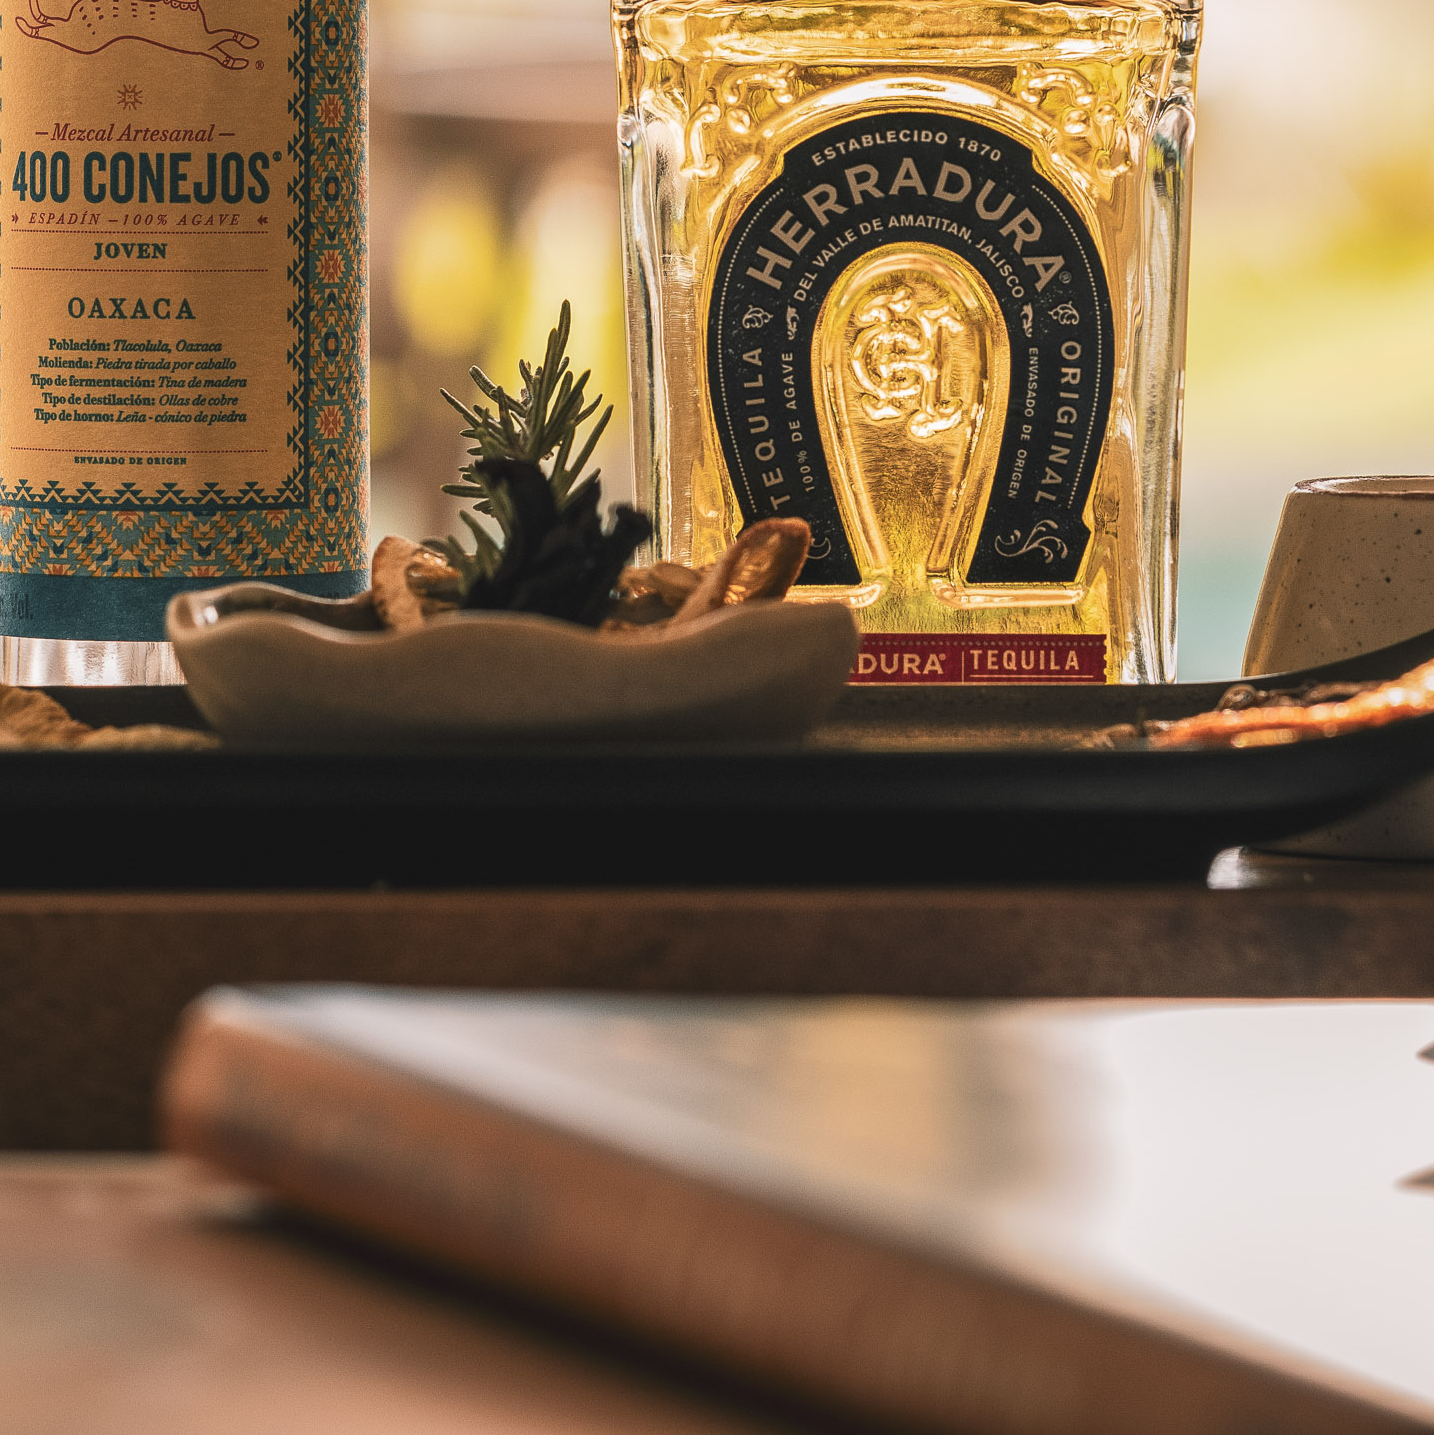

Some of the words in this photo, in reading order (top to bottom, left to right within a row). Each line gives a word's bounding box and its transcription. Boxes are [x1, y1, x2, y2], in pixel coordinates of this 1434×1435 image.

[117, 124, 216, 142] Artesanal
[811, 130, 948, 166] ESTABLECIDO
[958, 137, 1002, 162] 1870
[12, 151, 71, 203] 400
[28, 210, 101, 226] ESPADÍN
[177, 214, 240, 226] AGAVE
[94, 242, 167, 260] JOVEN
[794, 270, 818, 302] DEL
[812, 228, 858, 267] VALLE
[859, 218, 883, 235] DE
[975, 238, 1025, 298] JALISCO
[68, 297, 196, 320] OAXACA
[49, 338, 110, 352] Población:
[175, 339, 222, 352] Oaxaca
[38, 356, 93, 369] Molienda:
[95, 357, 132, 370] Piedra
[134, 358, 170, 370] tirada
[170, 361, 194, 373] por
[194, 358, 237, 370] caballo
[30, 374, 53, 389] Tipo
[54, 374, 67, 386] de
[68, 375, 156, 388] fermentación:
[158, 376, 185, 388] Tina
[188, 376, 201, 388] de
[203, 376, 247, 388] madera
[781, 352, 798, 410] AGAVE
[1024, 347, 1038, 417] ENVASADO
[42, 392, 66, 407] Tipo
[67, 393, 81, 405] de
[83, 393, 156, 406] destilación:
[158, 394, 190, 406] Ollas
[192, 394, 206, 406] de
[208, 394, 238, 406] cobre
[34, 408, 57, 424] Tipo
[58, 409, 72, 422] de
[73, 410, 114, 423] horno:
[115, 410, 147, 423] Leña
[154, 410, 192, 423] cónico
[193, 411, 207, 423] de
[207, 411, 247, 426] piedra
[1034, 341, 1082, 503] ORIGINAL
[742, 347, 791, 511] TEQUILA
[789, 419, 803, 442] DE
[1020, 424, 1032, 441] DE
[74, 456, 125, 465] ENVASADO
[129, 456, 143, 465] DE
[147, 457, 187, 465] ORIGEN
[796, 450, 815, 492] 100%
[1008, 449, 1027, 499] ORIGEN
[970, 649, 1080, 671] TEQUILA
